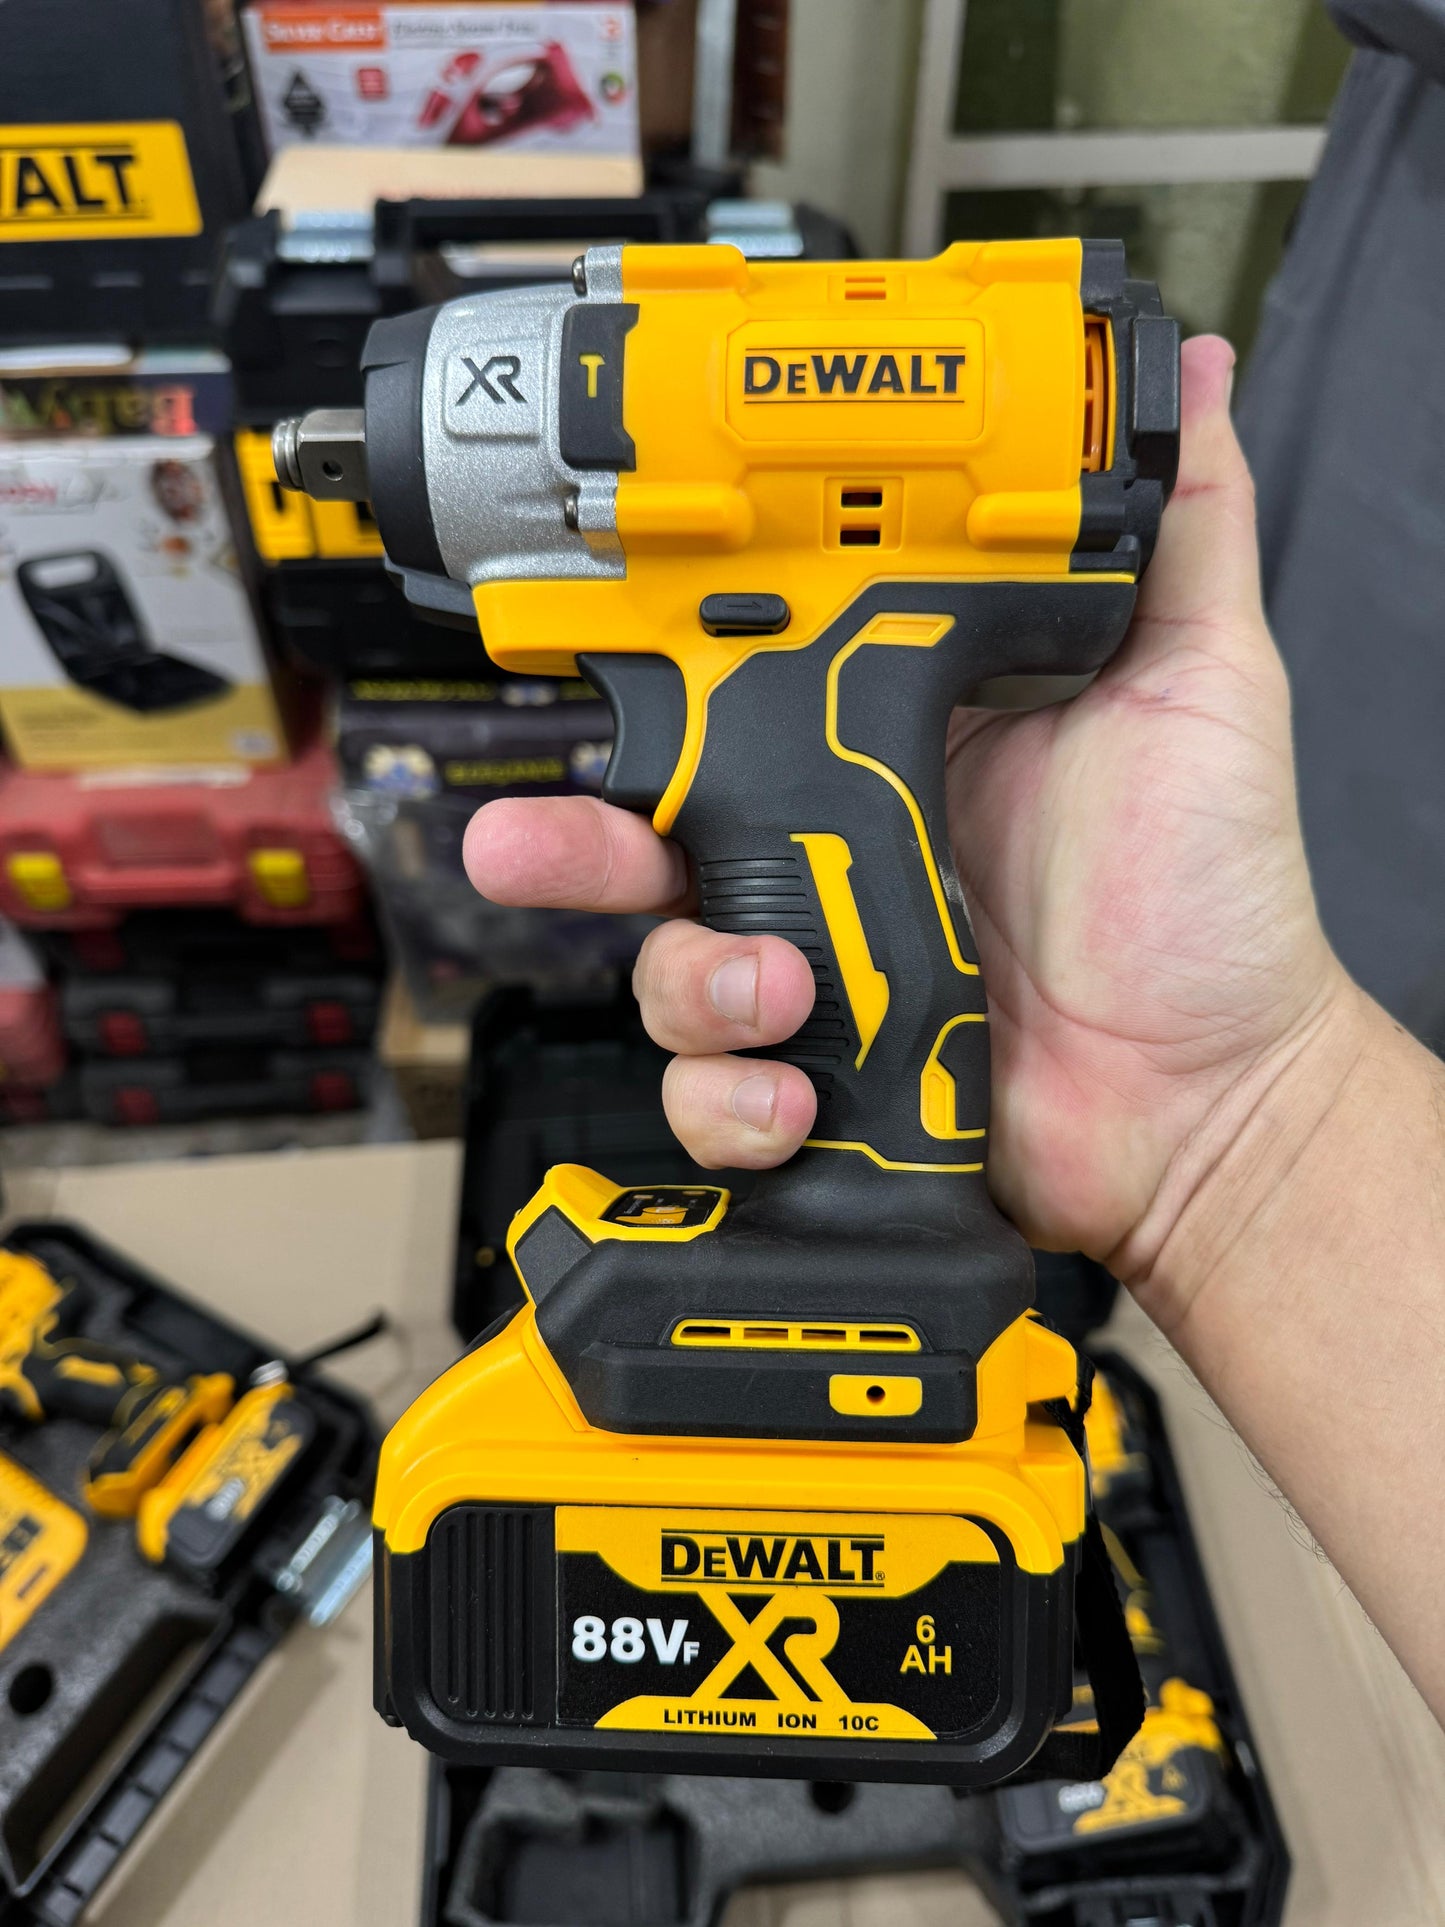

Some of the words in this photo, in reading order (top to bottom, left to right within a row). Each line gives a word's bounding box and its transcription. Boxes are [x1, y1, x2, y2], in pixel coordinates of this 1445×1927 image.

[0, 155, 136, 210] ALT
[455, 355, 528, 406] XR
[744, 355, 966, 394] DEWALT
[690, 1590, 852, 1702] XR
[916, 1614, 936, 1645] 6
[900, 1645, 953, 1675] AH
[664, 1709, 756, 1727] LITHIUM
[778, 1713, 817, 1730] ION
[839, 1715, 879, 1732] 10C
